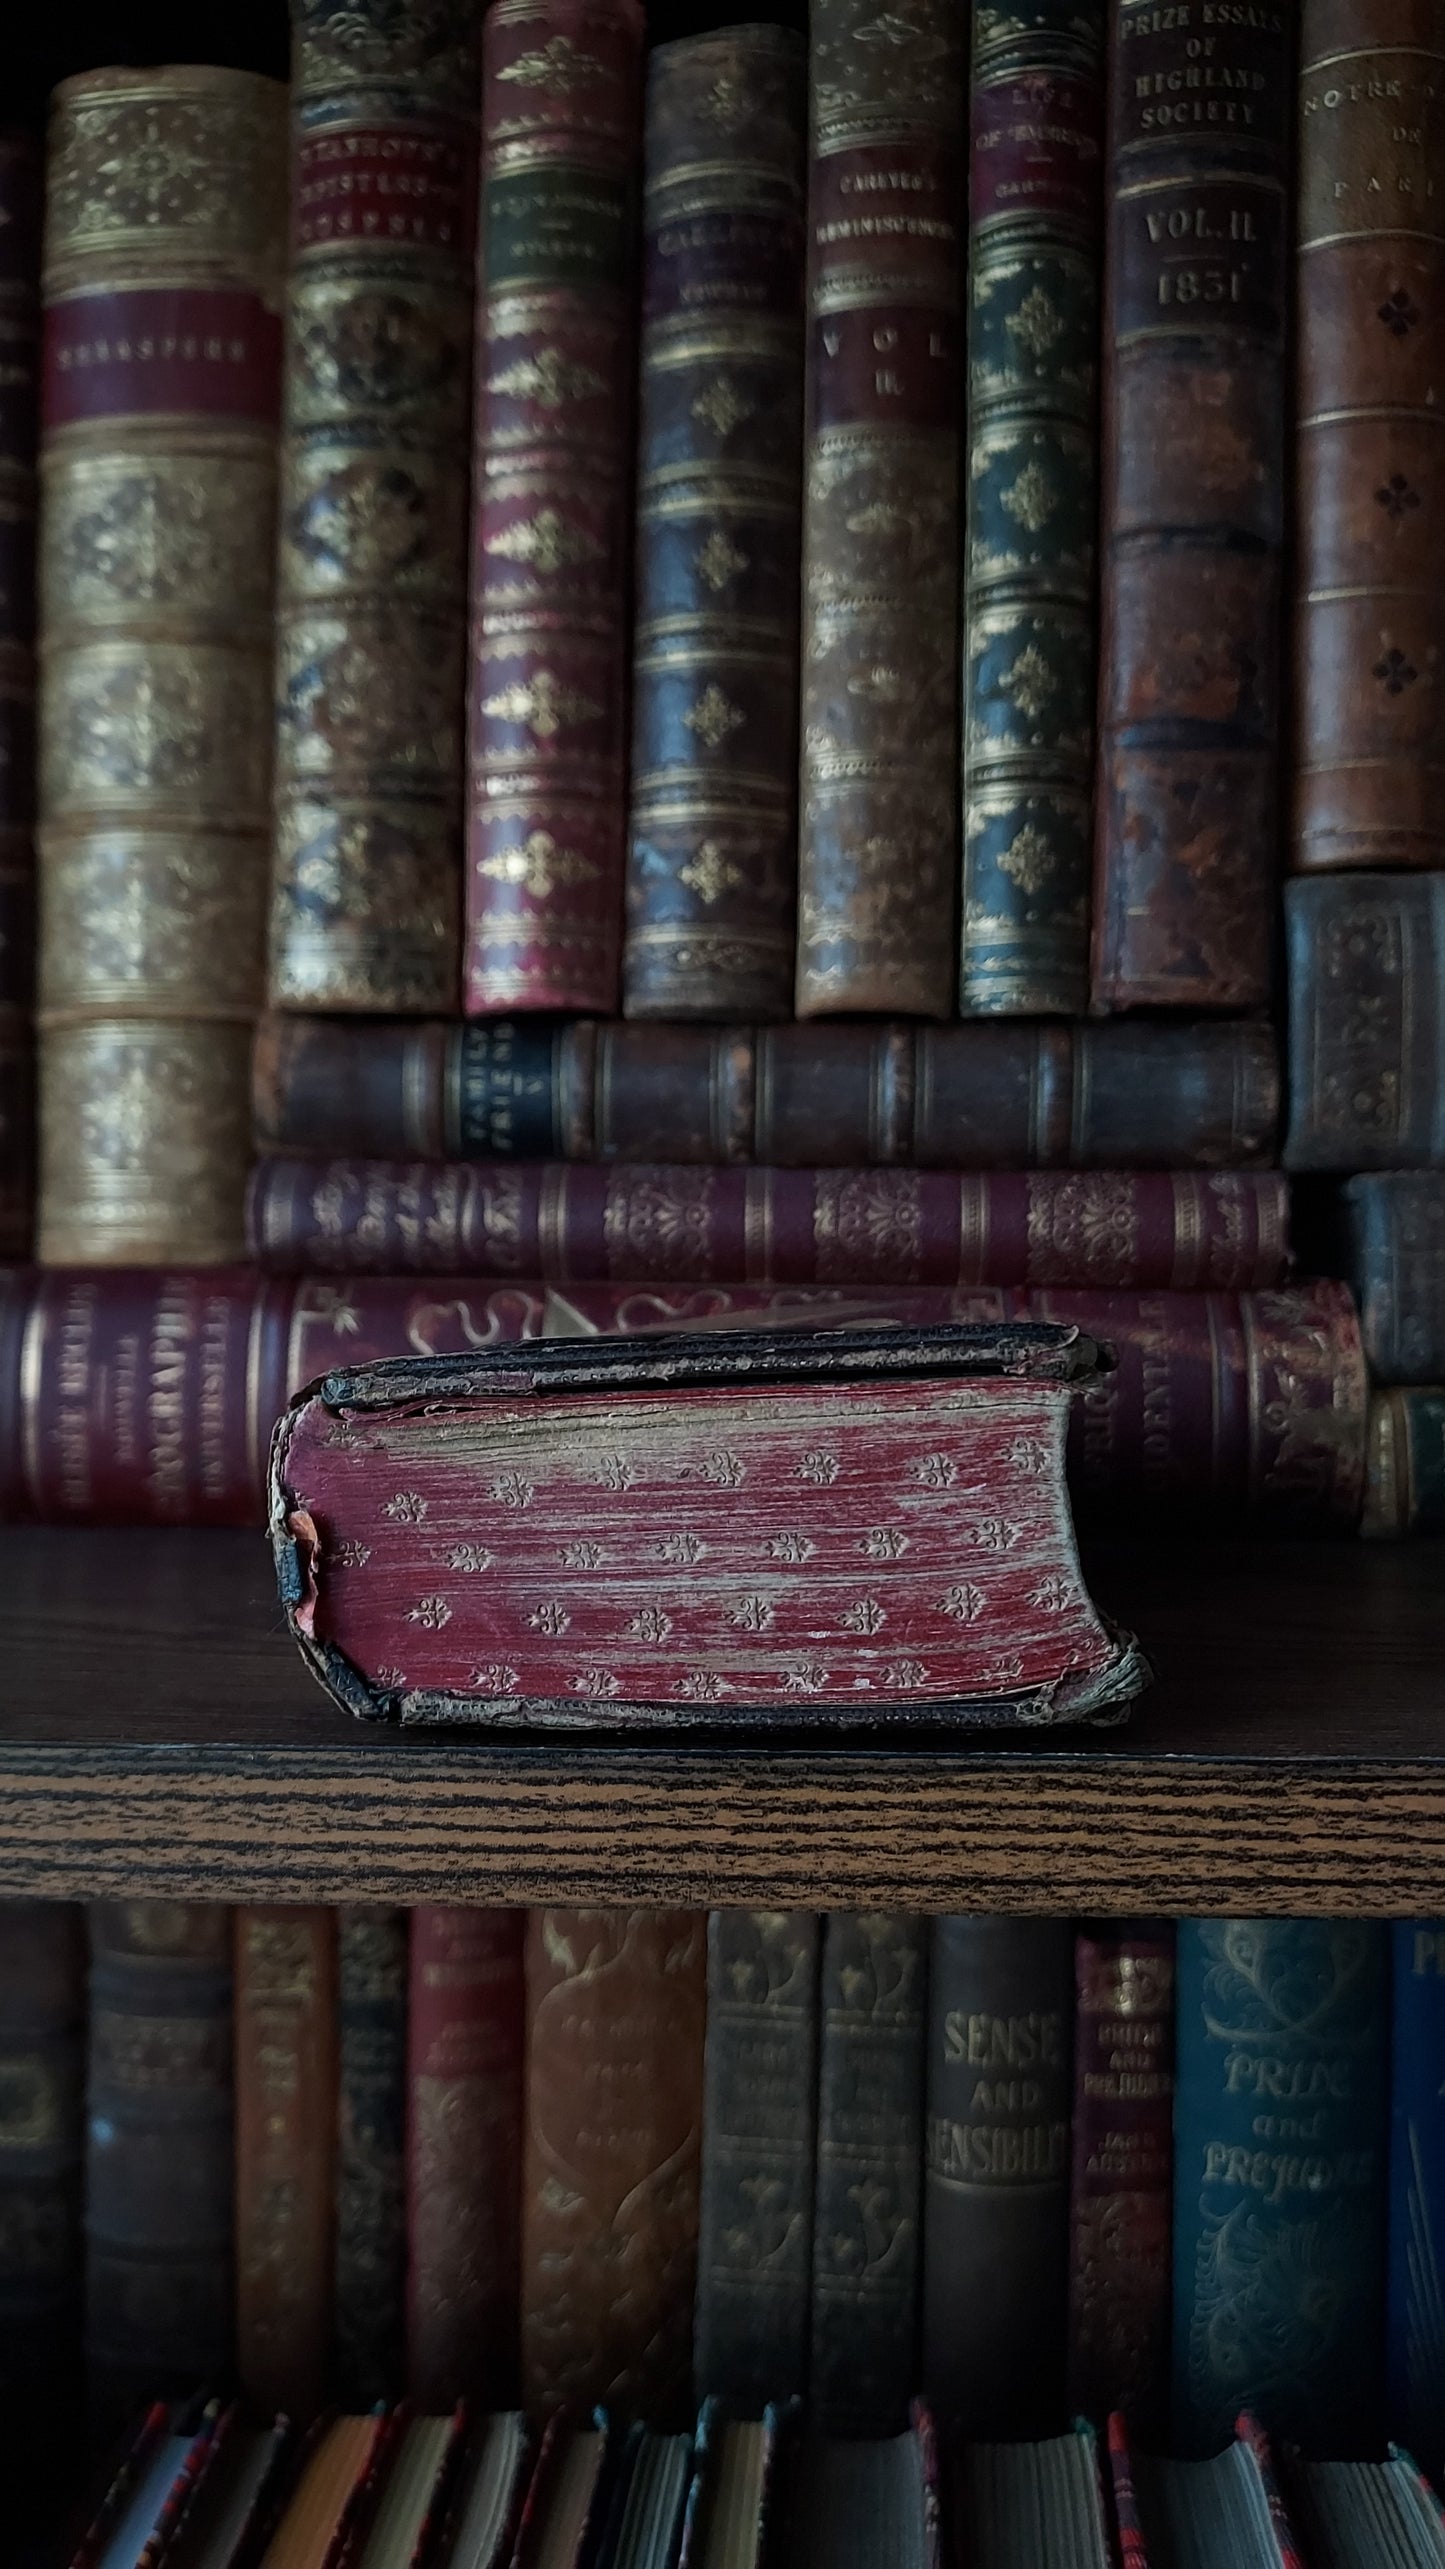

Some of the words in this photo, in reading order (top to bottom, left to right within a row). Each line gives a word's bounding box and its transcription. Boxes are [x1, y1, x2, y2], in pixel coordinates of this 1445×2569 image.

[1121, 4, 1190, 40] PRIZE
[1202, 3, 1281, 34] ESSAYS
[1186, 36, 1216, 59] OF
[1135, 66, 1265, 98] HIGHLAND
[1140, 101, 1256, 129] SOCIETY
[1333, 175, 1435, 199] PARI
[943, 2010, 1060, 2072] SENSE
[969, 2079, 1042, 2113] AND
[1252, 2106, 1328, 2140] and
